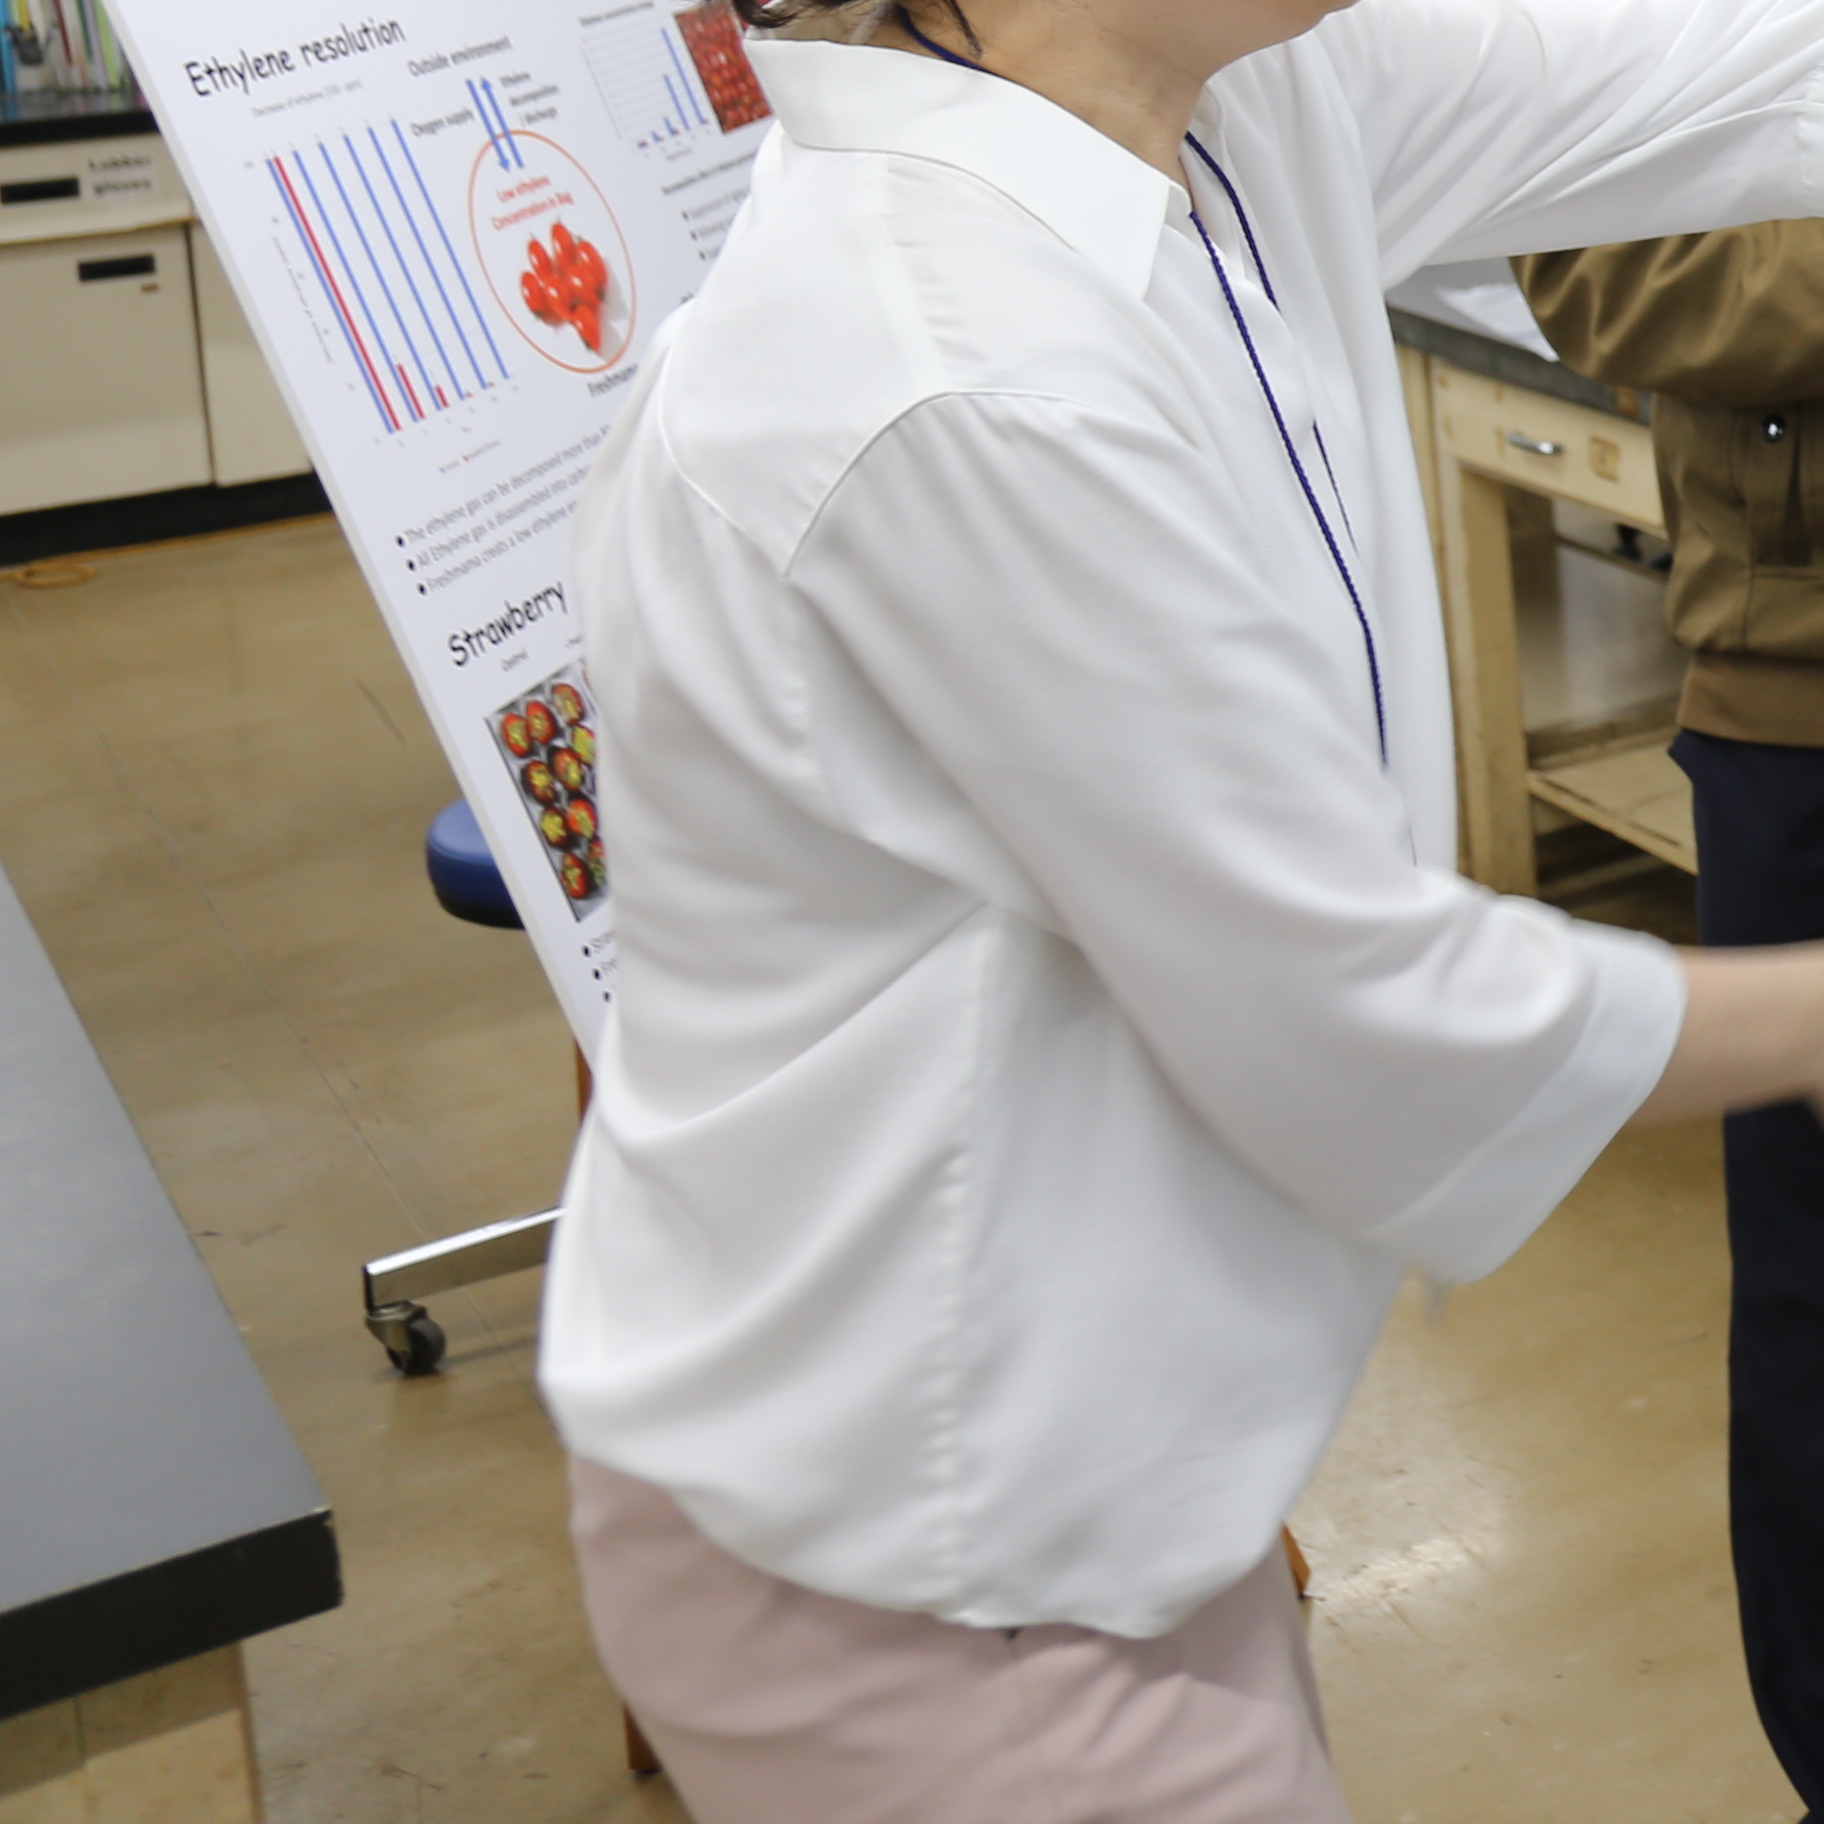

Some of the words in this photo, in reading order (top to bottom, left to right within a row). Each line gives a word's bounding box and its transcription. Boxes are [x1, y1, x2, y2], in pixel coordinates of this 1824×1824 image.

[184, 47, 295, 98] Ethylene
[298, 17, 408, 68] resolution
[448, 580, 569, 667] Strawberry
